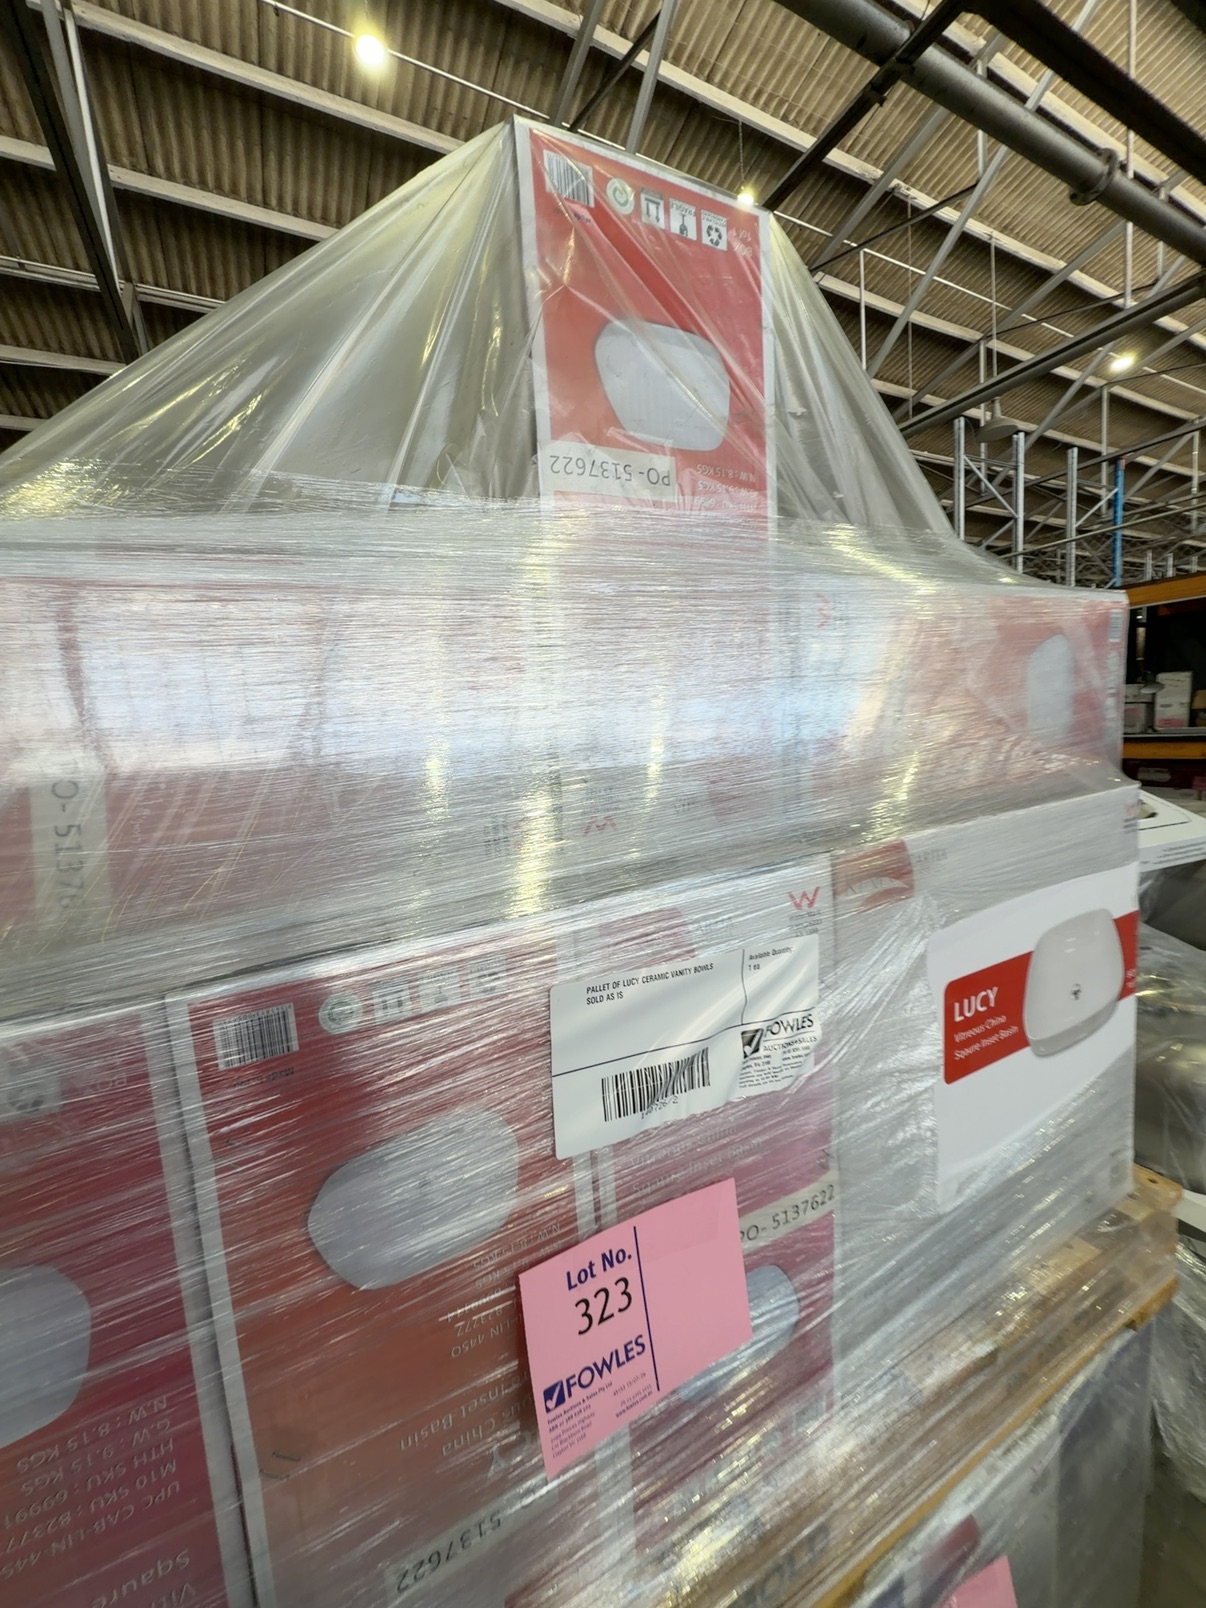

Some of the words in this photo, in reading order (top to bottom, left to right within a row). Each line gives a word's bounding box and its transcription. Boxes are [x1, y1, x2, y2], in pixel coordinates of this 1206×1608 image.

[548, 454, 632, 483] 5137622
[638, 466, 671, 487] PO-
[696, 463, 715, 476] KGS
[697, 479, 715, 491] KGS
[586, 982, 610, 994] PALLET
[612, 980, 621, 989] OF
[622, 977, 640, 988] LUCY
[641, 971, 670, 984] CERAMIC
[671, 967, 693, 979] VANITY
[693, 962, 714, 974] BOWLS
[586, 994, 604, 1005] SOLD
[606, 992, 615, 1002] AS
[617, 991, 624, 1000] IS
[954, 986, 999, 1023] LUCY
[764, 1013, 814, 1038] FOWLES
[772, 1184, 835, 1230] 5137622
[566, 1260, 597, 1291] Lot
[601, 1249, 632, 1273] No.
[574, 1276, 633, 1336] 323
[565, 1333, 646, 1399] FOWLES
[128, 1395, 167, 1426] N.W
[67, 1423, 110, 1449] 8.15
[132, 1418, 171, 1447] G.W
[400, 1412, 453, 1451] Basin
[440, 1417, 497, 1457] China
[16, 1445, 60, 1474] KGS
[71, 1446, 114, 1473] 9.15
[133, 1438, 174, 1469] HTH
[20, 1465, 64, 1497] KGS
[87, 1463, 127, 1491] SKU
[135, 1460, 177, 1489] M10
[89, 1485, 129, 1514] SKU
[143, 1481, 181, 1511] UPC
